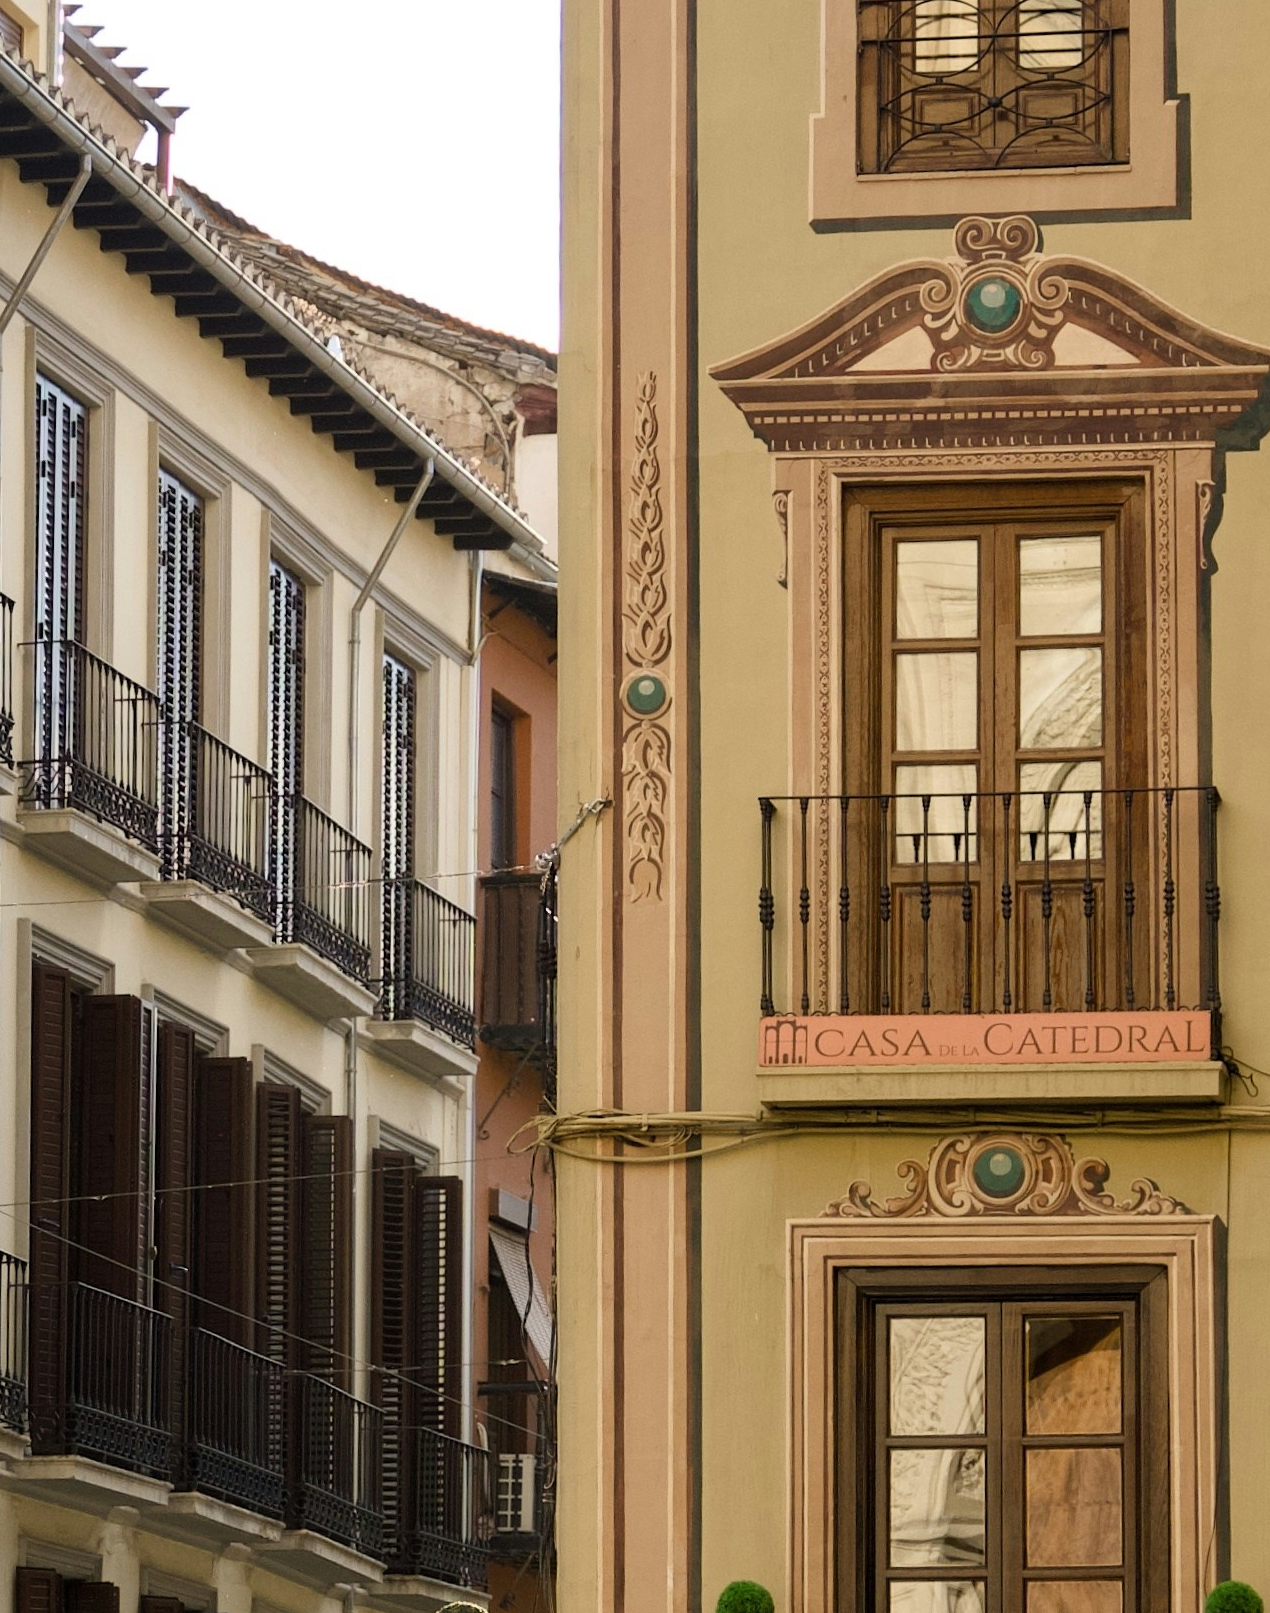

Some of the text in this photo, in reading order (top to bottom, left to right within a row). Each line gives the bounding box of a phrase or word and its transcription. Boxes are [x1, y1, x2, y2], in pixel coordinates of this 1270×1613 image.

[814, 1020, 1206, 1058] CASA DE LA CATEDRAL
